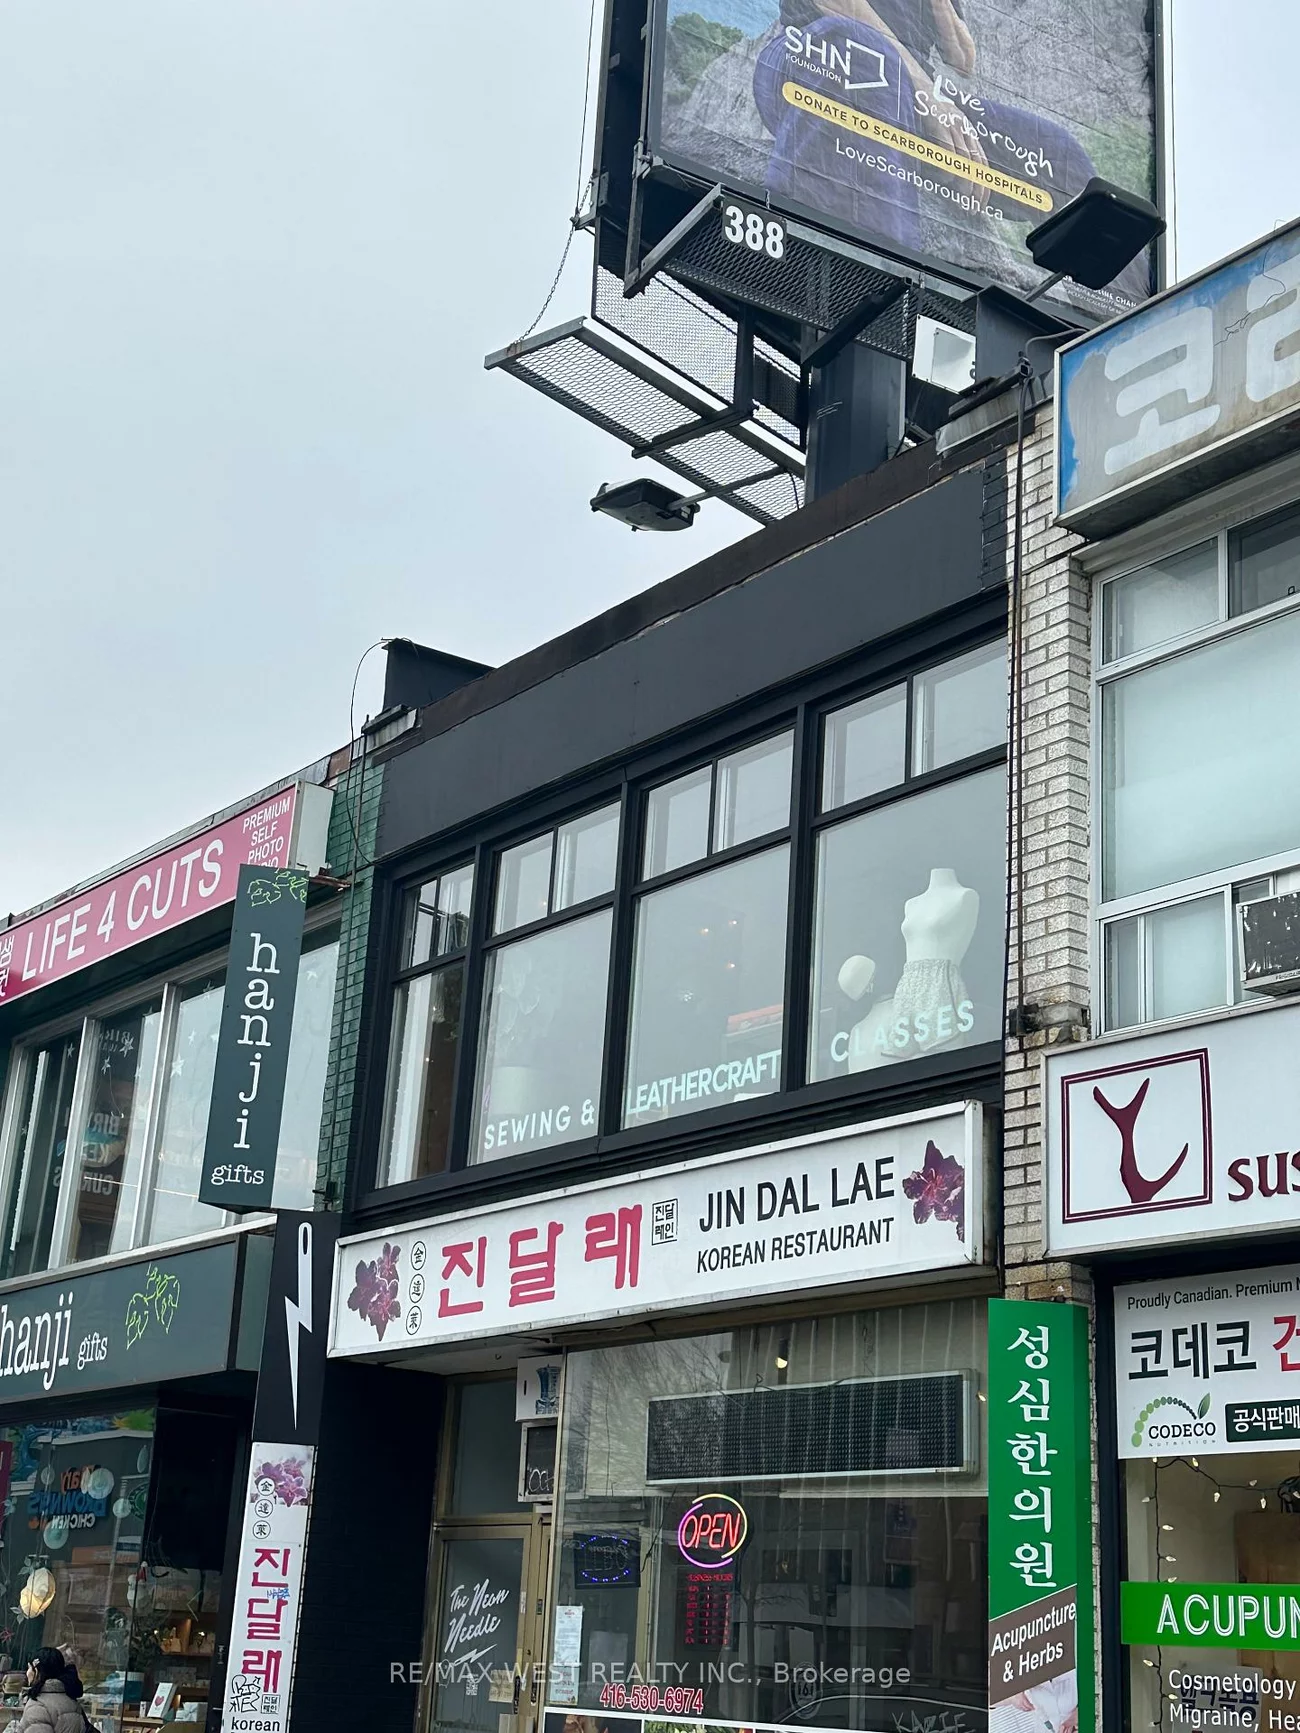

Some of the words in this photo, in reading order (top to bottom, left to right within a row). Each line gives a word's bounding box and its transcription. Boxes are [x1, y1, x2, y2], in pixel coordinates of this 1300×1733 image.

[785, 25, 851, 76] SHN
[785, 53, 842, 83] FOUNDATION
[794, 90, 848, 121] DONATE
[851, 115, 869, 131] TO
[873, 125, 971, 175] SCARBOROUGH
[976, 168, 1043, 204] HOSPITALS
[914, 90, 1054, 178] Scarborough
[836, 138, 1003, 221] LoveScarborough.ca
[725, 205, 784, 259] 388
[242, 796, 291, 834] PREMIUM
[250, 820, 279, 847] SELF
[247, 836, 284, 865] PHOTO
[21, 903, 92, 982] LIFE
[96, 900, 118, 944] 4
[126, 838, 225, 931] CUTS
[233, 932, 281, 1149] hanji
[483, 1104, 571, 1150] SEWING
[580, 1098, 596, 1127] &
[626, 1049, 782, 1115] LEATHERCRAFT
[830, 999, 975, 1062] CLASSES
[210, 1163, 265, 1186] gifts
[699, 1186, 745, 1233] JIN
[757, 1173, 820, 1222] DAL
[831, 1156, 895, 1208] LAE
[438, 1204, 643, 1319] 진달래
[697, 1239, 766, 1274] KOREAN
[771, 1217, 895, 1261] RESTAURANT
[1127, 1292, 1171, 1311] Proudly
[1173, 1286, 1233, 1305] Canadian.
[1235, 1279, 1293, 1298] Premium
[0, 1291, 74, 1391] hanji
[76, 1332, 108, 1371] gifts
[1128, 1320, 1257, 1380] 코데코
[1006, 1325, 1058, 1588] 성심한의원
[1148, 1422, 1217, 1440] CODECO
[681, 1513, 741, 1549] OPEN
[241, 1547, 292, 1693] 진달래
[450, 1584, 469, 1612] The
[468, 1578, 510, 1616] Neon
[444, 1612, 501, 1653] Needle
[991, 1602, 1076, 1657] Acupuncture
[1002, 1660, 1014, 1683] &
[1018, 1641, 1064, 1676] Herbs
[1168, 1669, 1297, 1701] Cosmetology
[230, 1716, 281, 1732] korean
[600, 1682, 704, 1715] 416-530-6974
[1169, 1702, 1260, 1733] Migraine,
